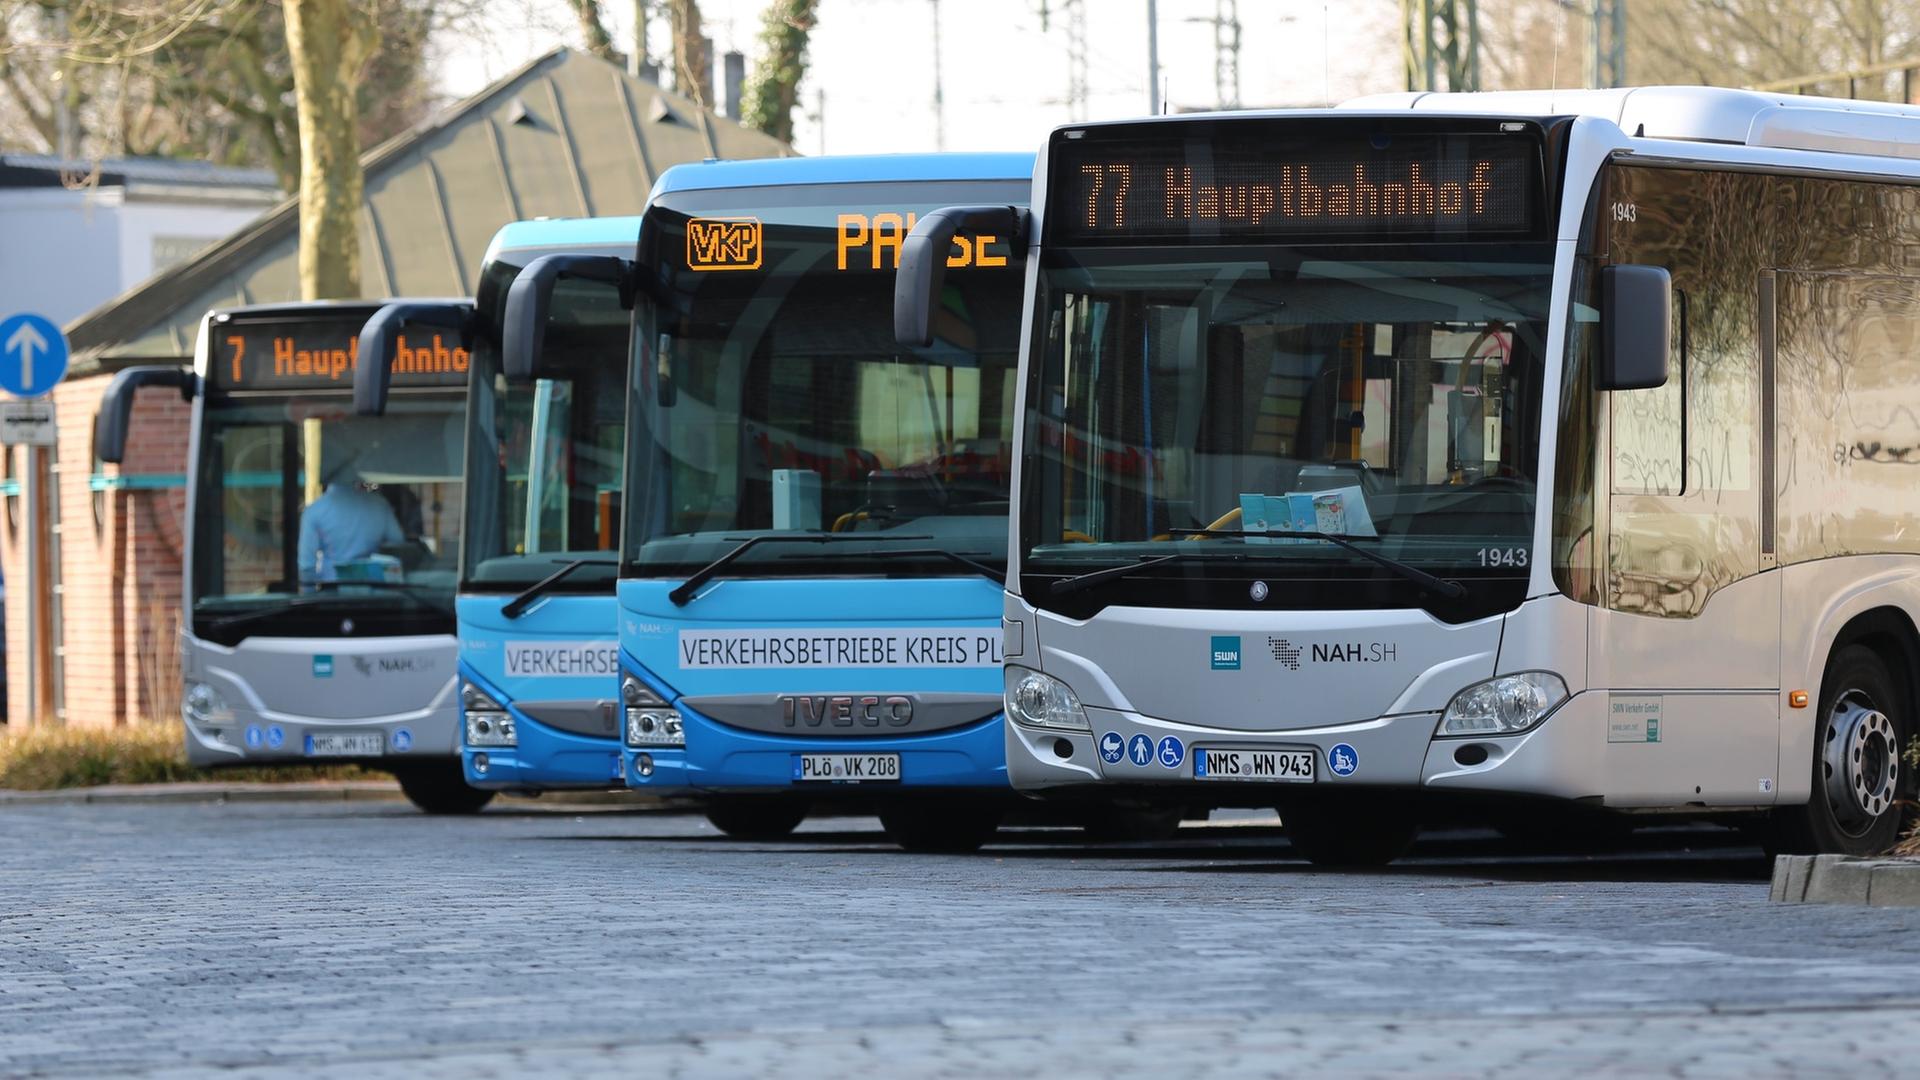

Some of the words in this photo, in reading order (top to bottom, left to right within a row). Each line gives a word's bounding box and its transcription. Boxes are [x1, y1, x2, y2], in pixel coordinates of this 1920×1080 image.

[1081, 164, 1130, 227] 77
[1166, 161, 1490, 225] Hauptbahnhof
[1611, 202, 1636, 222] 1943
[690, 222, 758, 262] VKP
[837, 212, 1006, 269] PASE
[227, 336, 245, 382] 7
[1477, 548, 1528, 567] 1943
[682, 637, 897, 665] VERKEHRSBETRIEBE
[906, 636, 967, 663] KREIS
[977, 637, 1004, 663] PL
[1214, 651, 1238, 661] SWN
[1312, 642, 1397, 662] NAH.SH
[783, 696, 913, 727] IVECO
[844, 757, 863, 775] VK
[868, 757, 896, 775] 208
[1207, 753, 1240, 774] NMS
[1253, 754, 1275, 775] WN
[1280, 754, 1312, 776] 943
